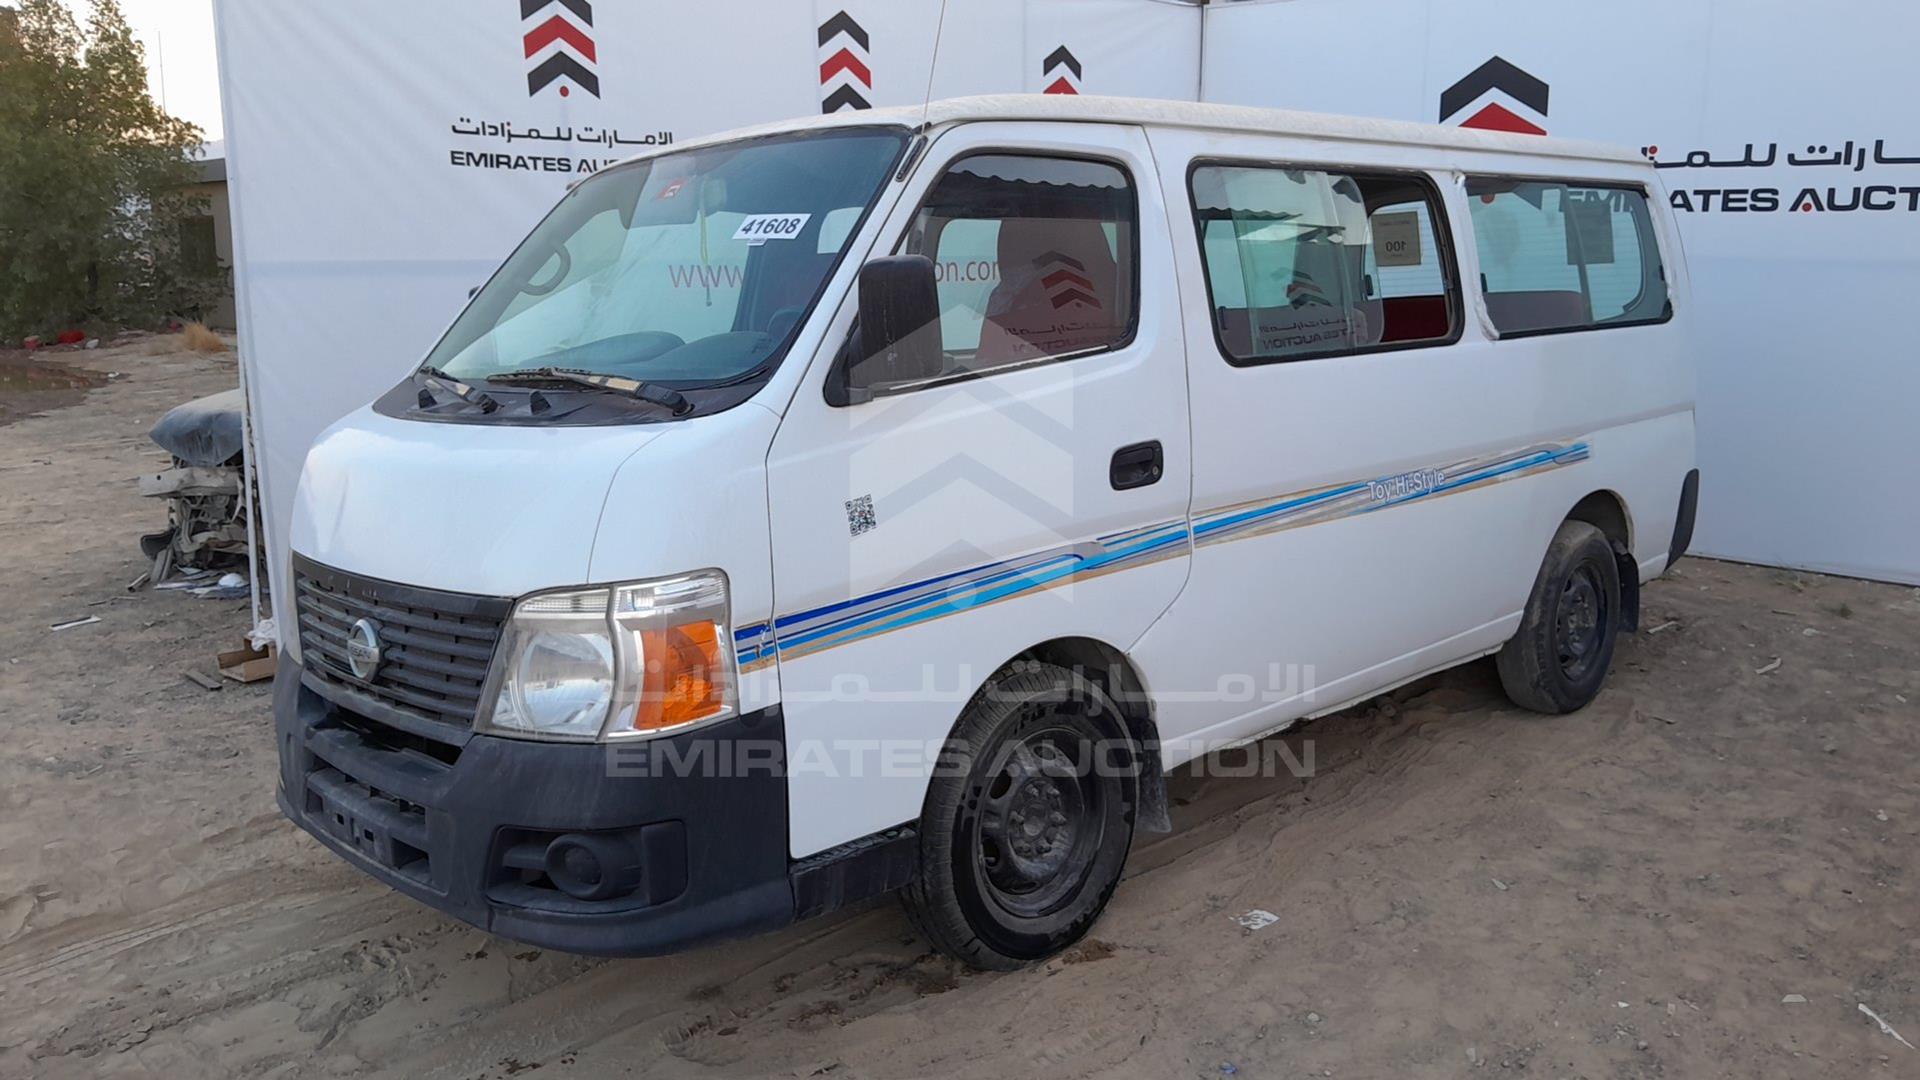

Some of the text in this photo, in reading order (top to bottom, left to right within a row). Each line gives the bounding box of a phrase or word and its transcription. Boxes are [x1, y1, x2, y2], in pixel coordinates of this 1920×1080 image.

[450, 150, 572, 173] EMIRATES
[1788, 185, 1920, 212] AUCT
[741, 218, 801, 235] 41608
[1367, 469, 1446, 503] Toy Hi-Style
